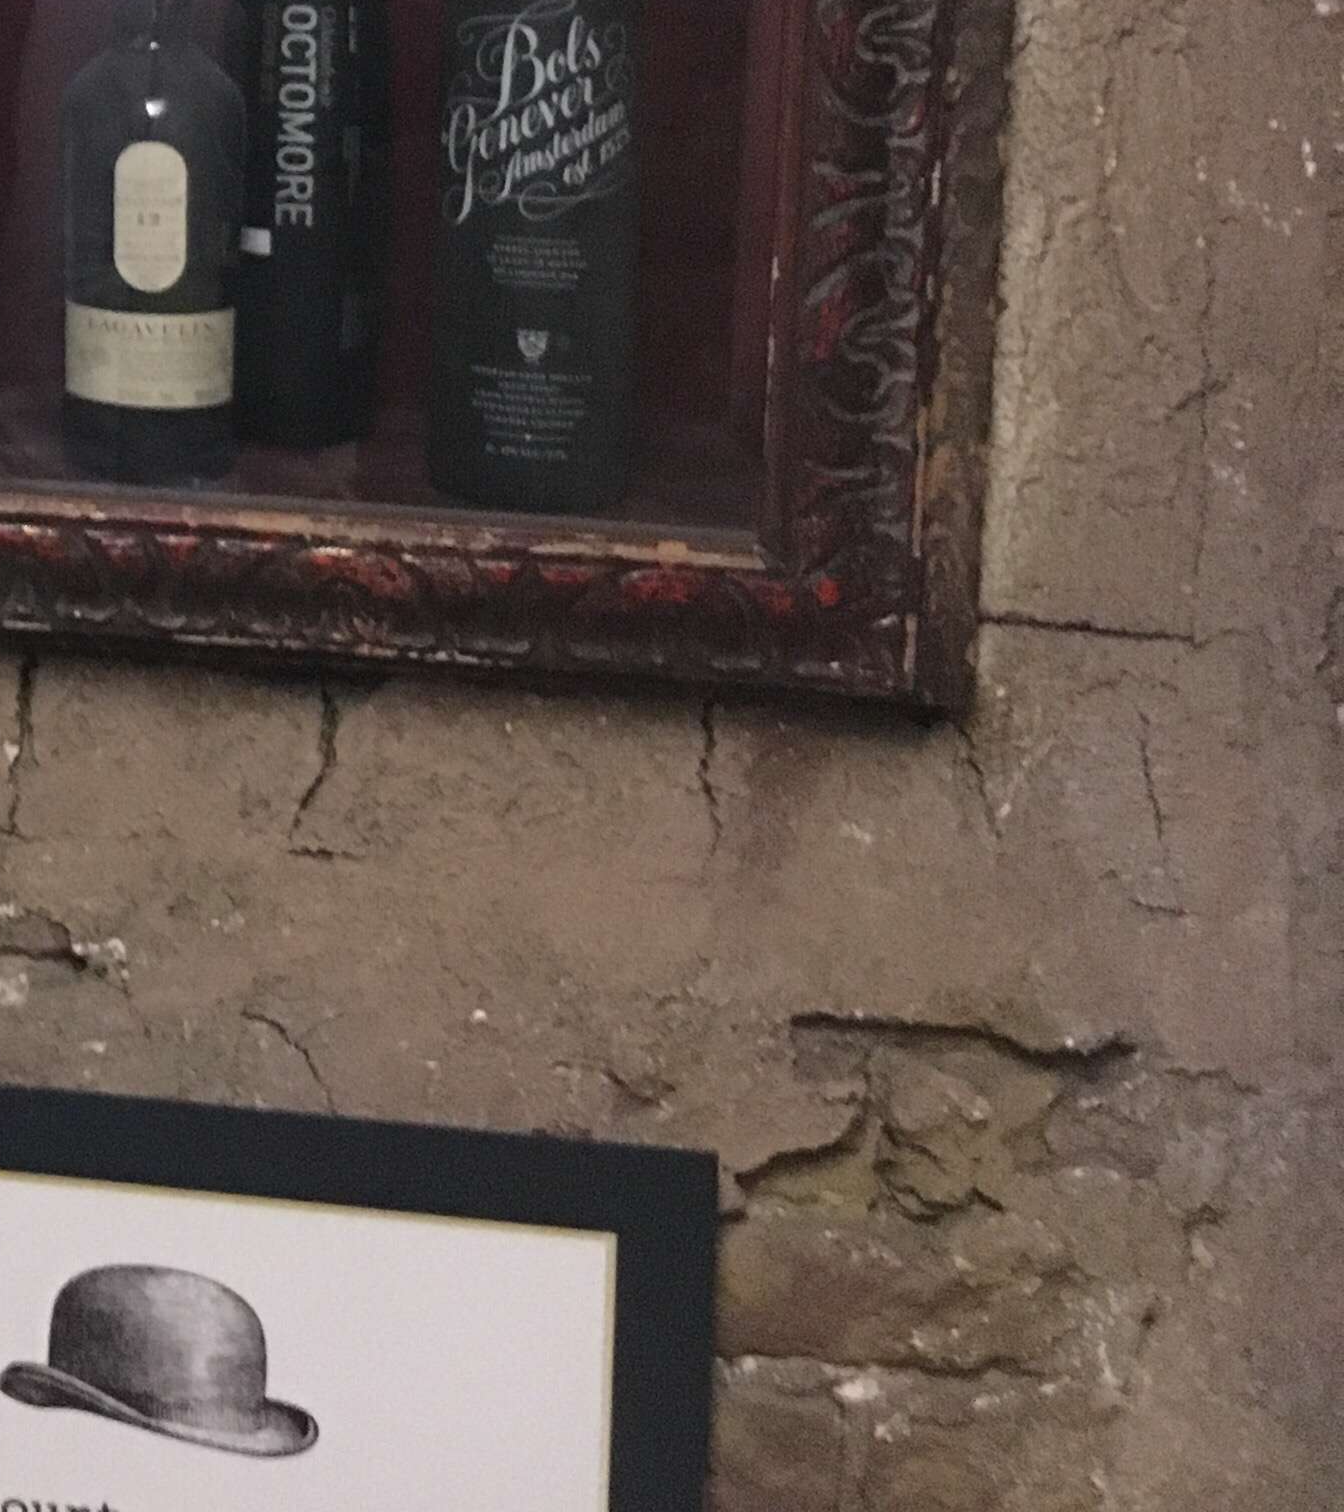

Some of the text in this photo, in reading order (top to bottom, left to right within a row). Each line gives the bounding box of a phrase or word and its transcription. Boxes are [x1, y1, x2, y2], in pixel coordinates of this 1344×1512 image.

[274, 3, 319, 228] OCTOMORE
[478, 10, 602, 118] Bols
[448, 75, 593, 225] Genever
